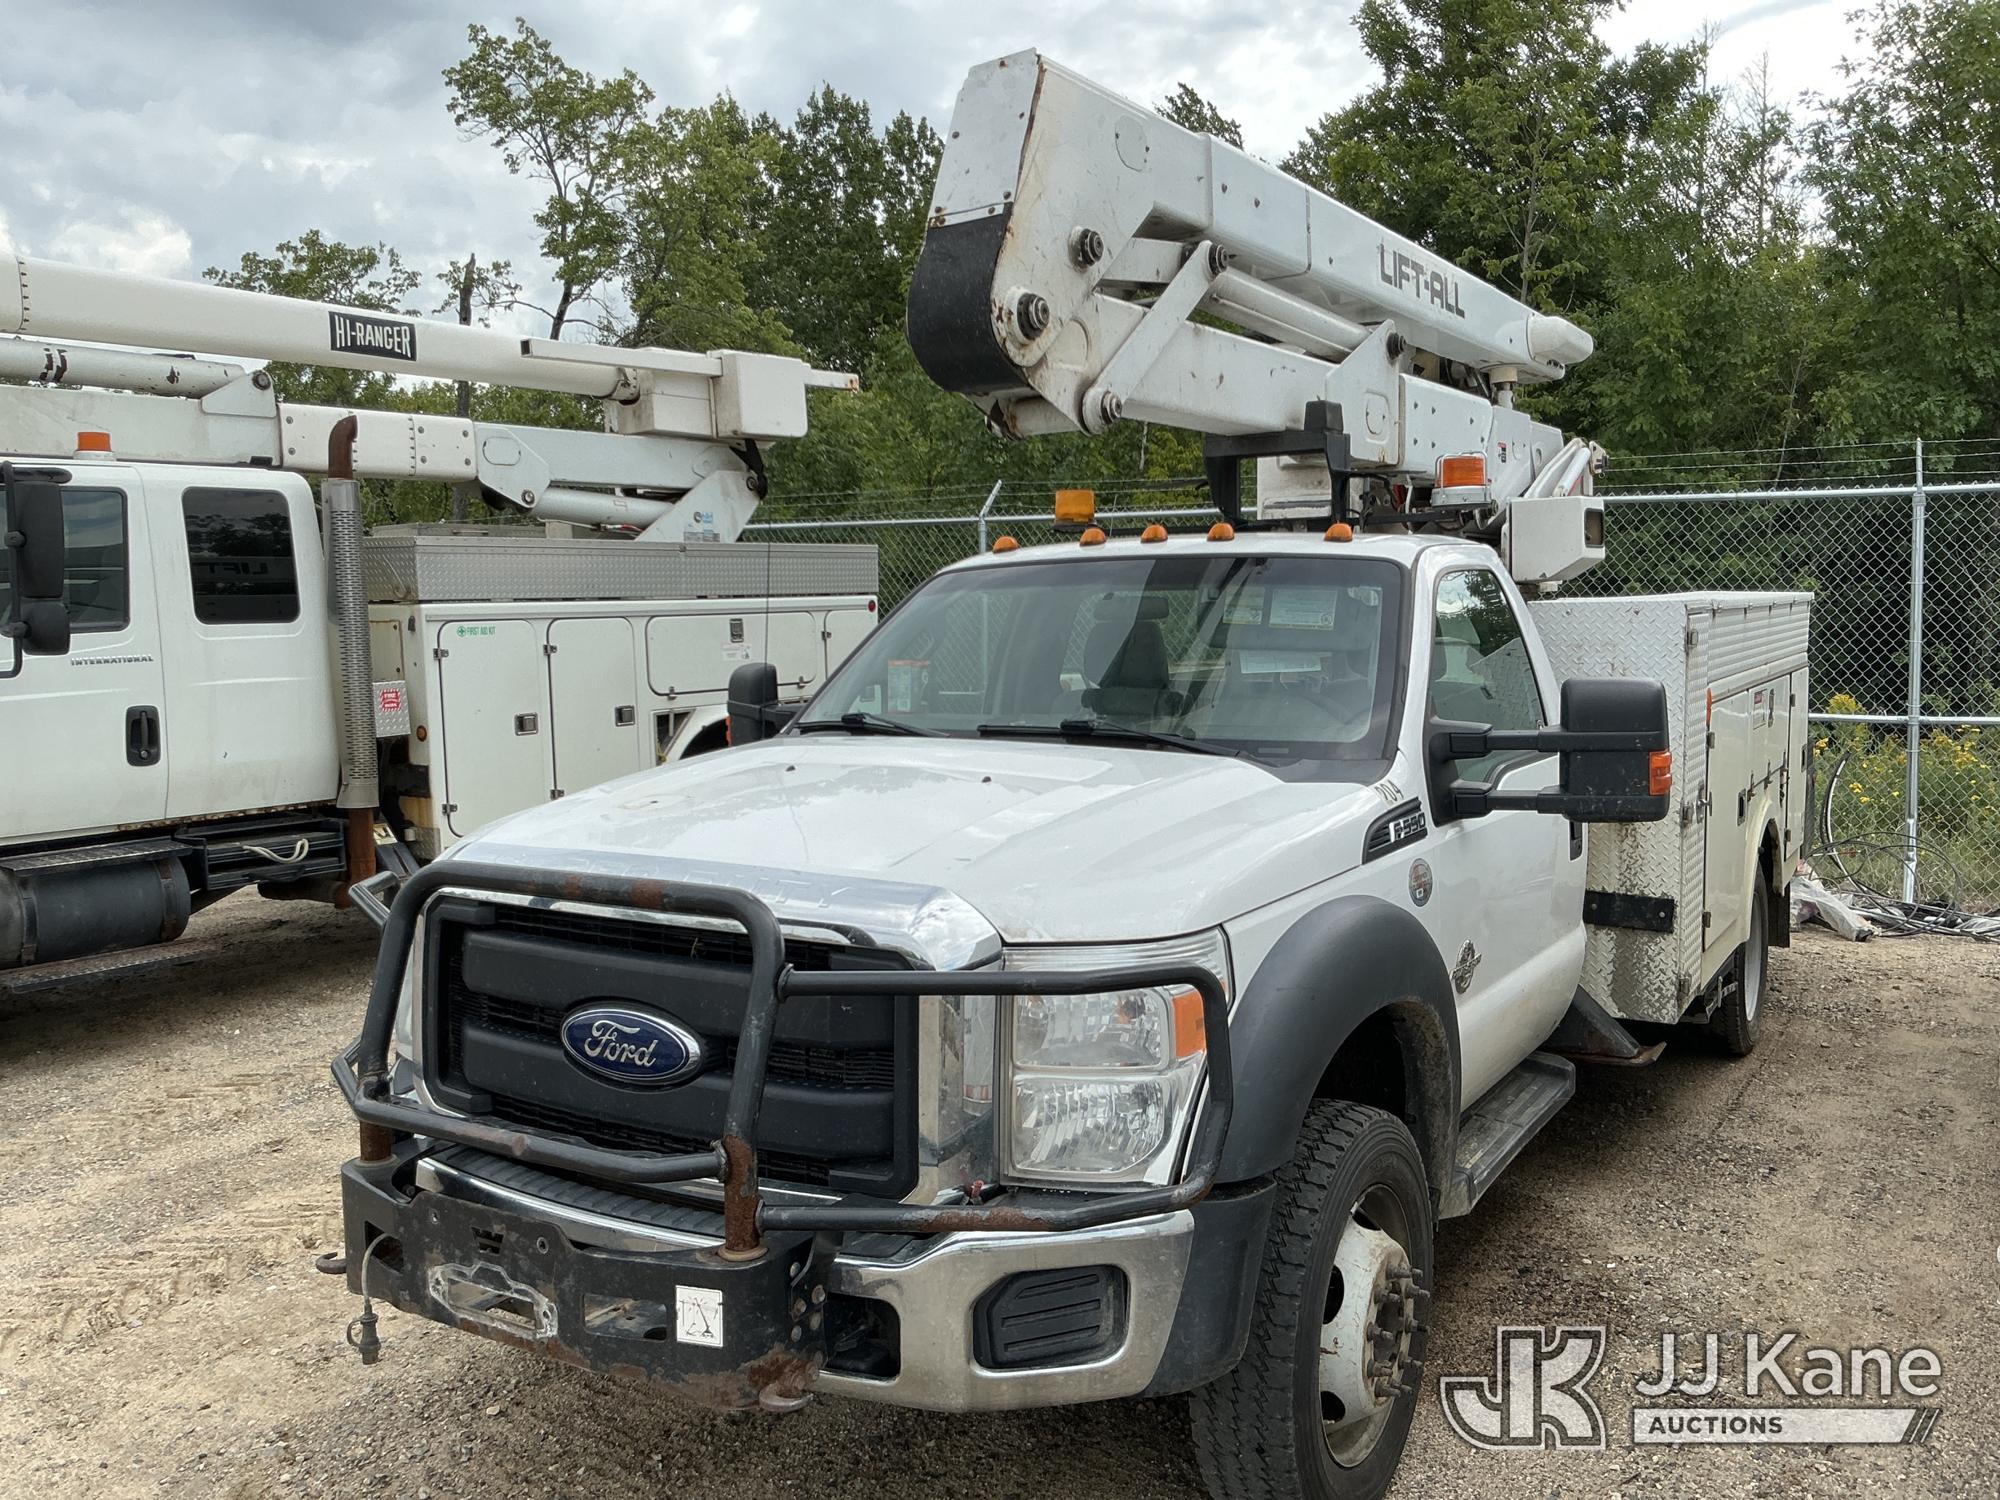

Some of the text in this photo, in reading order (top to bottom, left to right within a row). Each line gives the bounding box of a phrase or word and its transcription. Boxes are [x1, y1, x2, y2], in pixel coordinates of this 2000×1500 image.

[1380, 243, 1465, 319] LIFT-ALL
[334, 314, 412, 358] HI-RANGER
[71, 654, 154, 666] INTERNATIONAL
[584, 1020, 658, 1067] Ford
